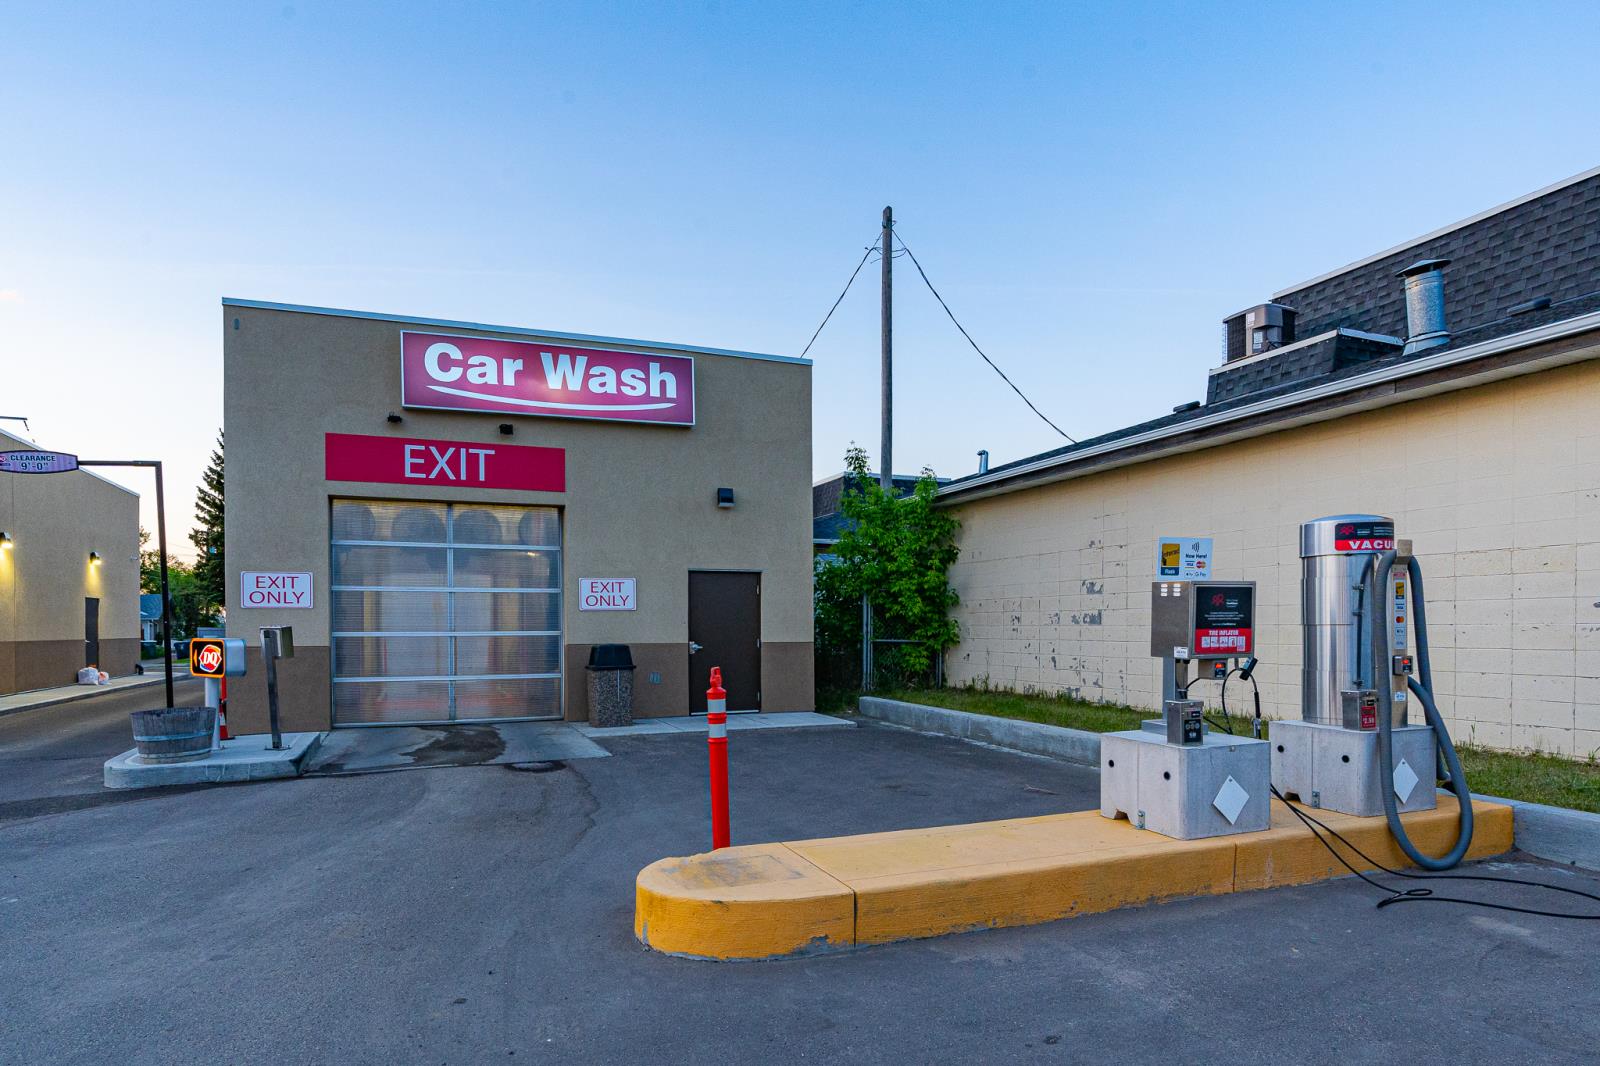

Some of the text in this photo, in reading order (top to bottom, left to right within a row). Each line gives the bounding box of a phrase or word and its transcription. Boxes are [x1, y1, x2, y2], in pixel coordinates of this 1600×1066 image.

[424, 343, 677, 399] Car Wash
[404, 444, 495, 481] EXIT
[256, 575, 299, 589] EXIT
[591, 581, 624, 593] EXIT
[249, 591, 304, 604] ONLY
[585, 594, 629, 606] ONLY
[203, 651, 217, 667] DQ
